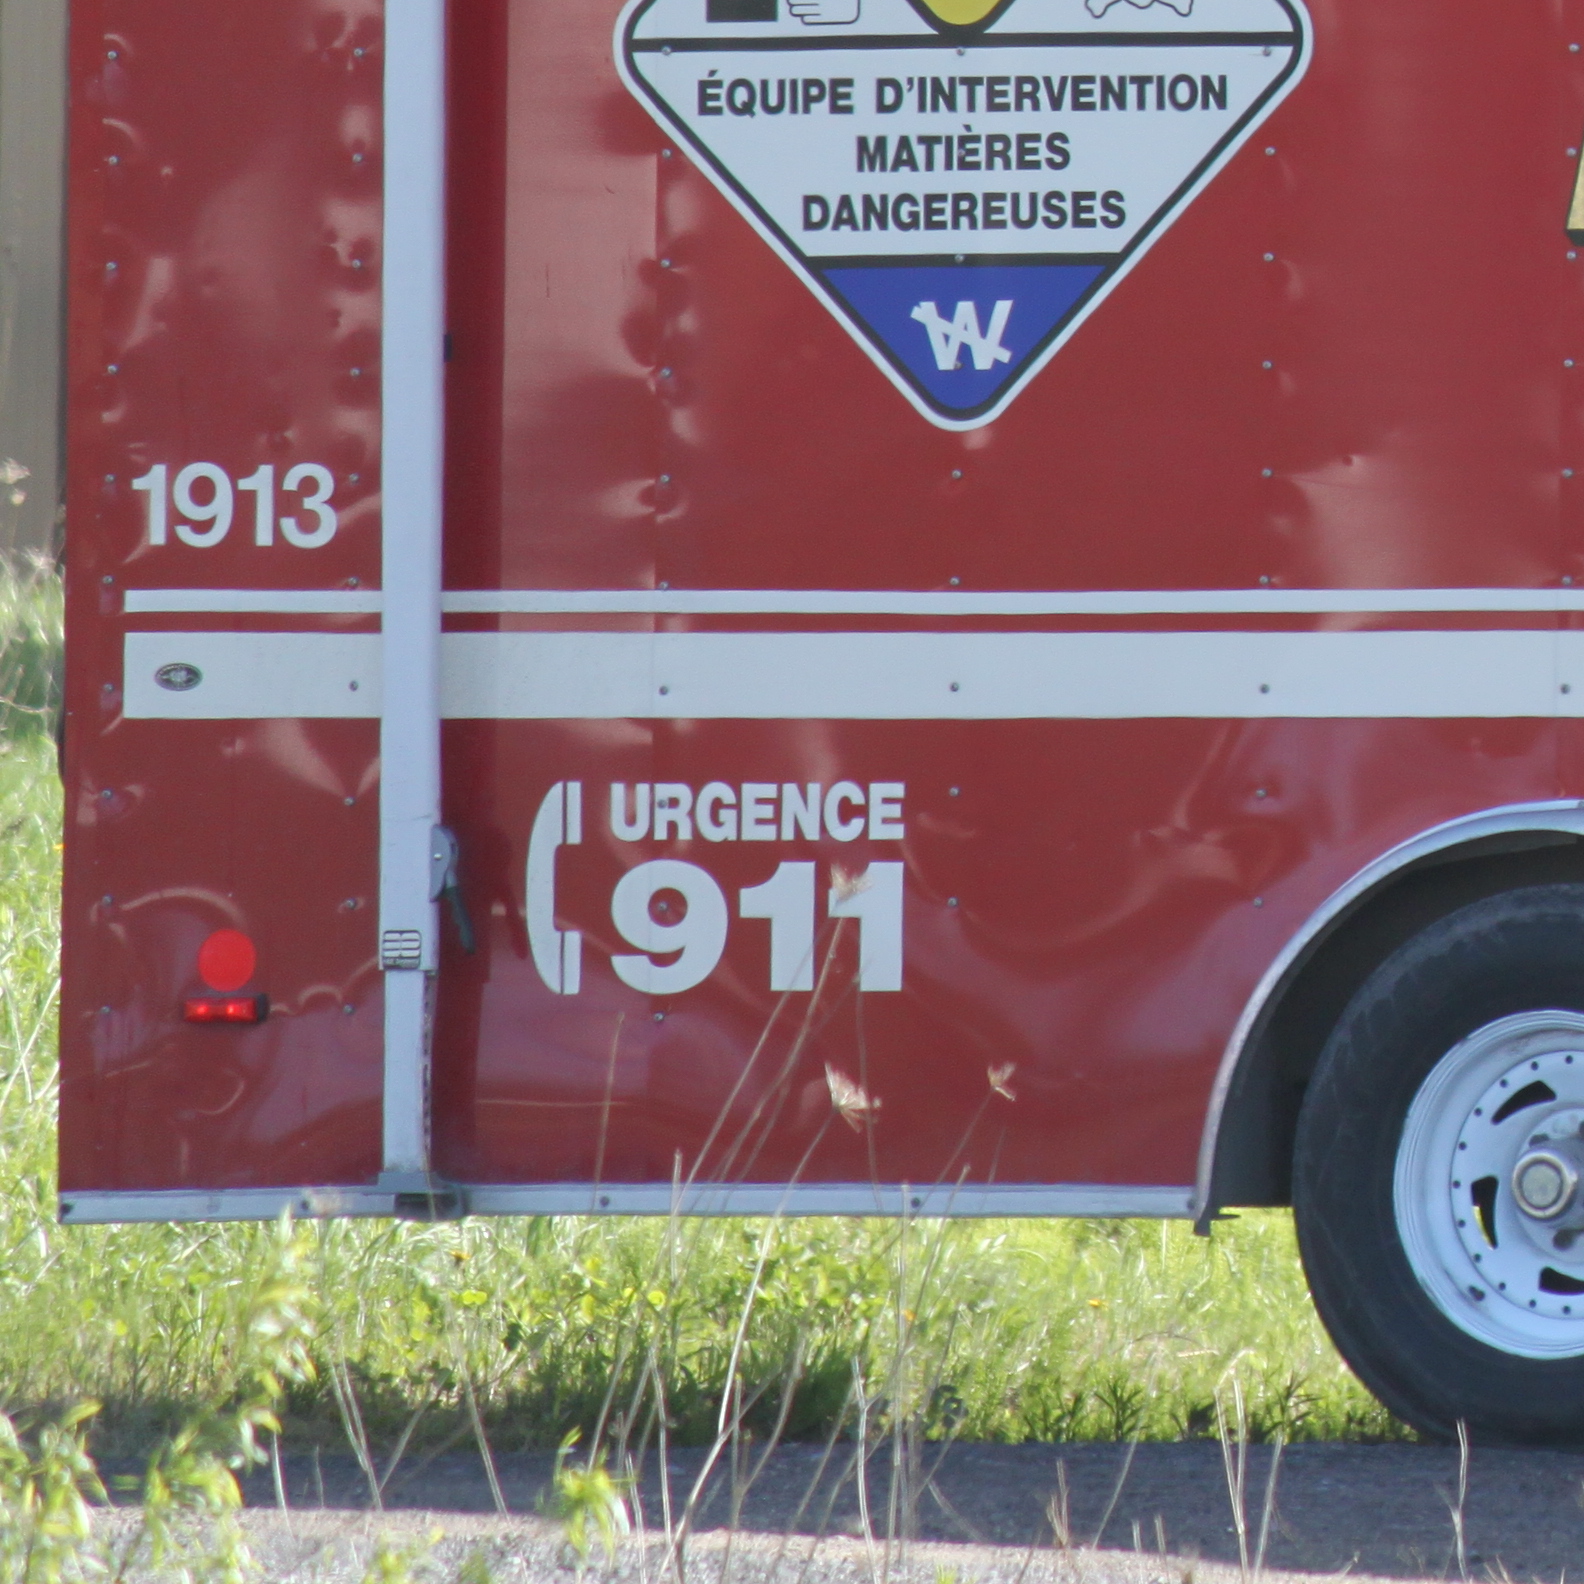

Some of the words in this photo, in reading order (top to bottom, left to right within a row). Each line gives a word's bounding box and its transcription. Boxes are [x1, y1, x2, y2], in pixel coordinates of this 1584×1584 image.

[697, 70, 854, 117] ÉQUIPE
[875, 74, 1228, 113] D'INTERVENTION
[855, 124, 1072, 173] MATIÈRES
[801, 190, 1127, 232] DANGEREUSES
[131, 461, 338, 549] 1913
[609, 780, 906, 843] URGENCE
[610, 858, 905, 995] 911
